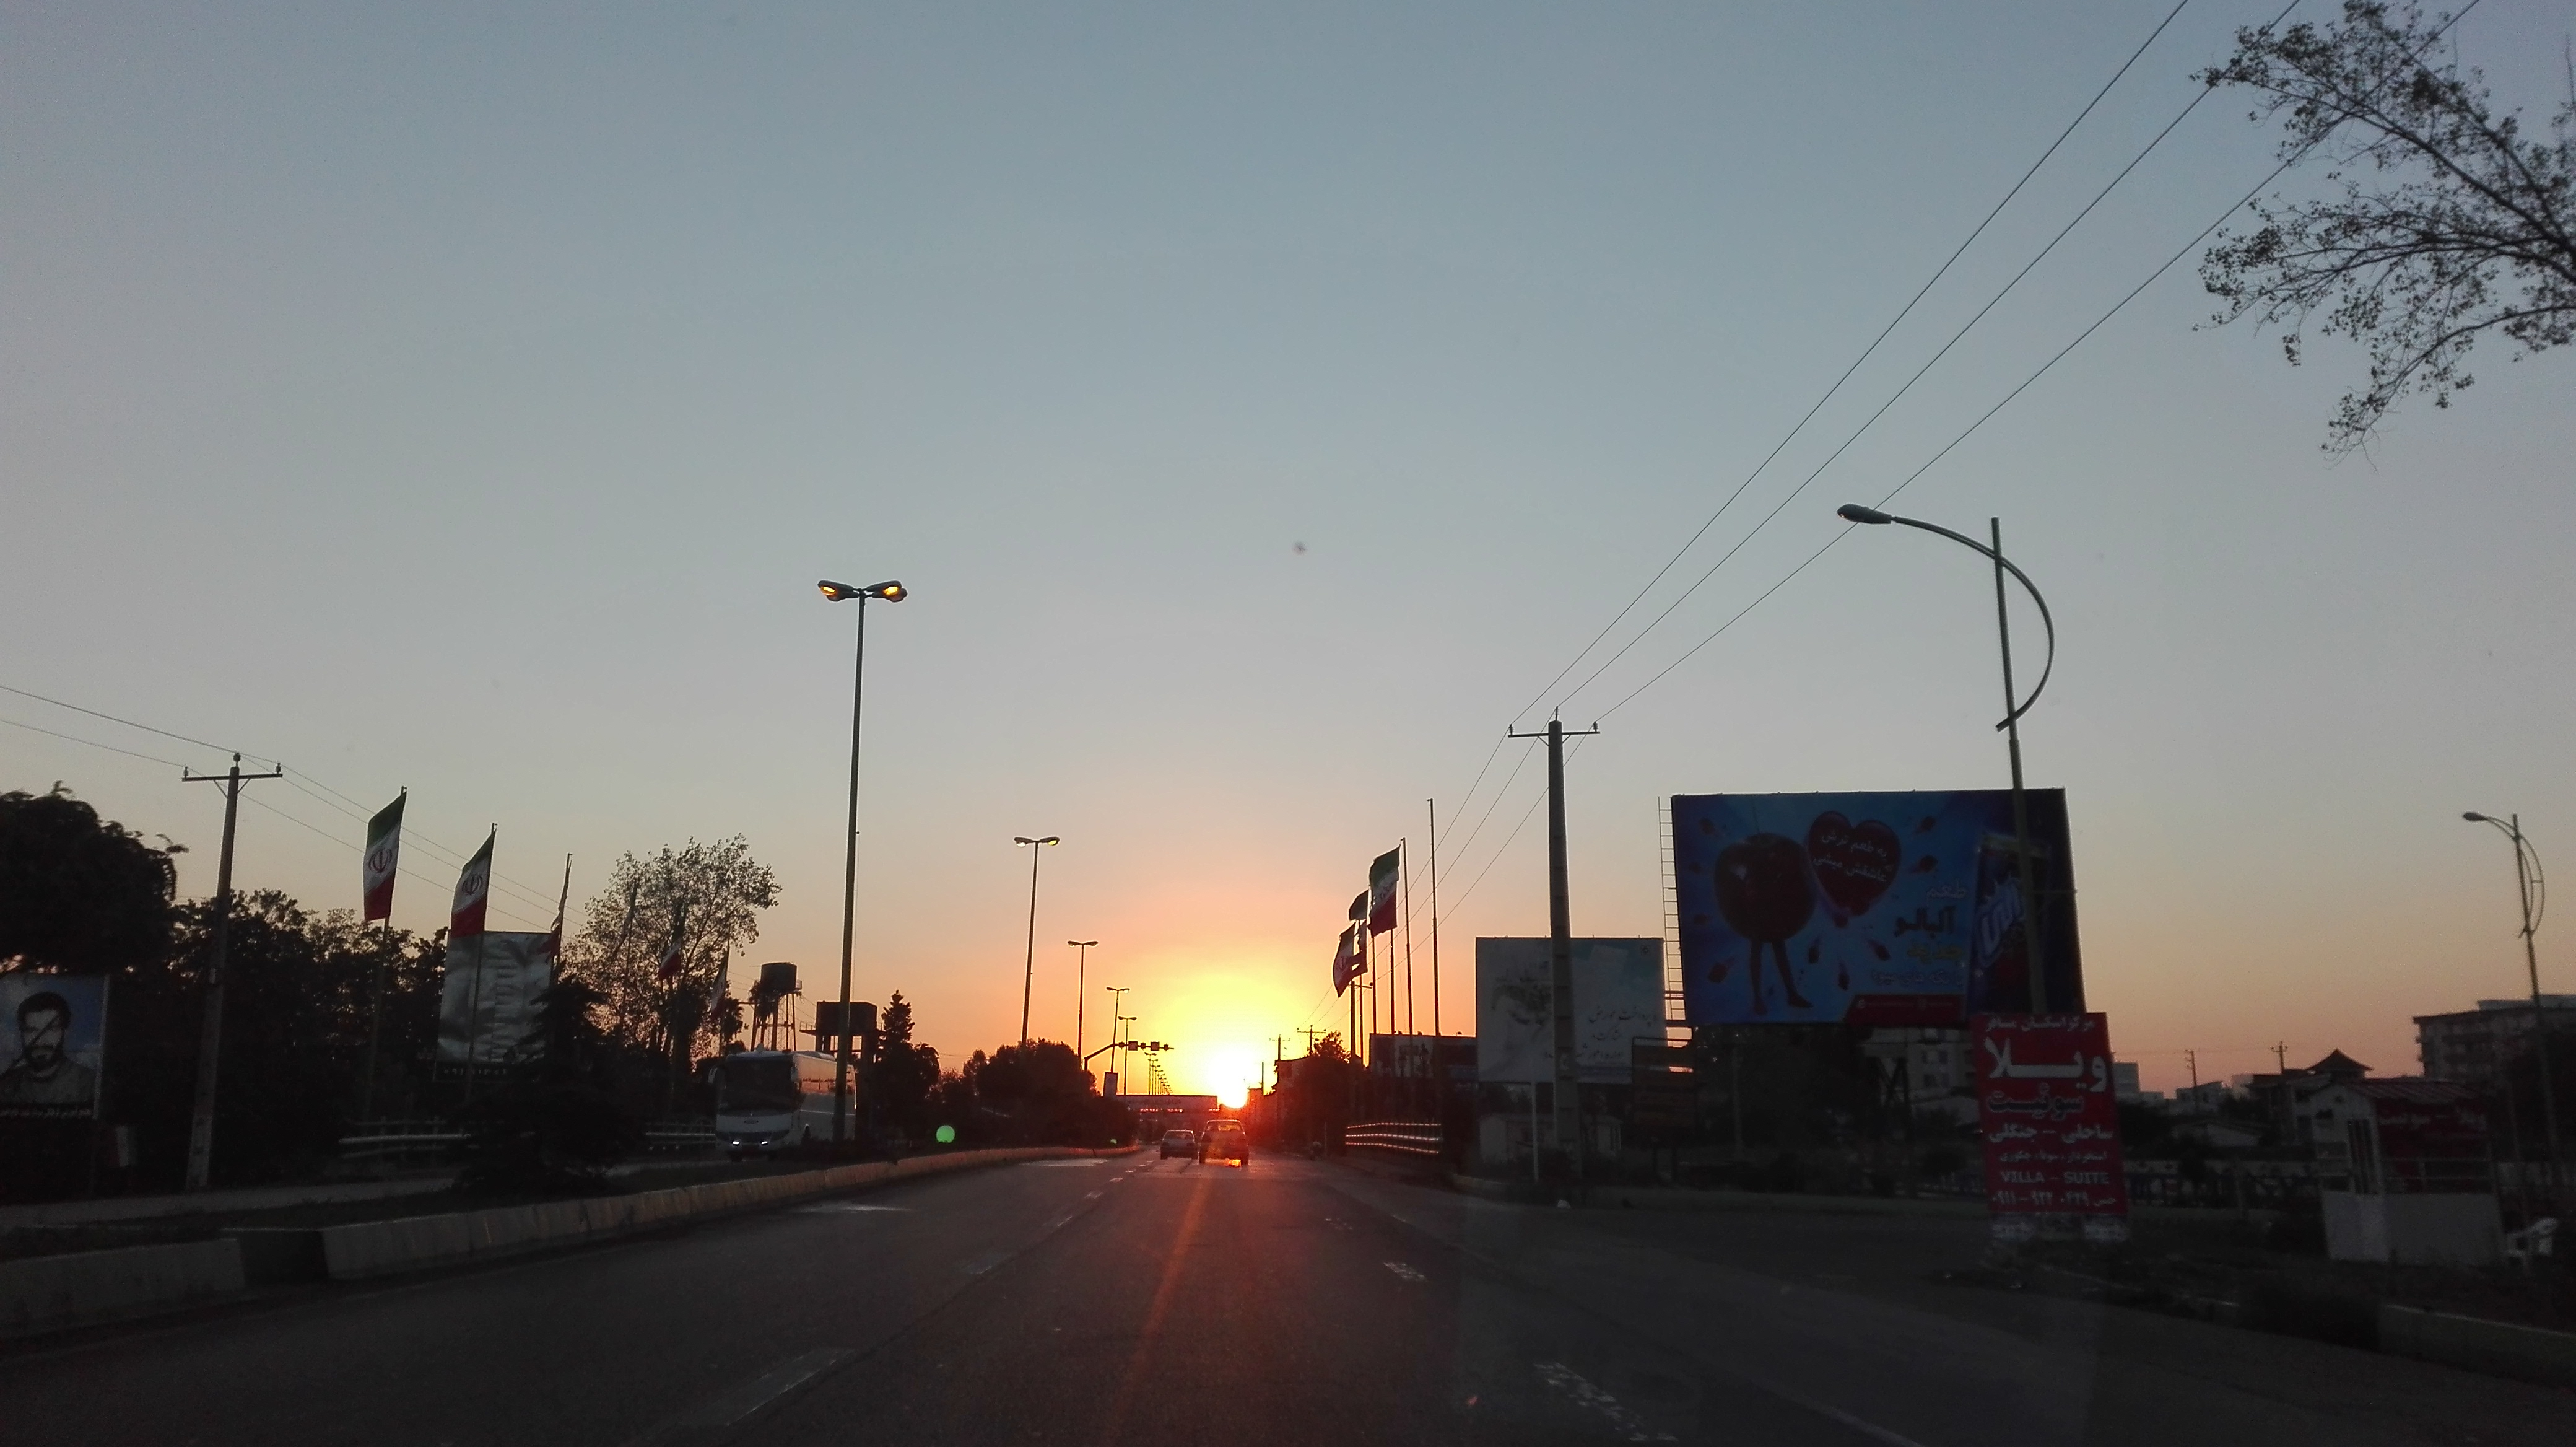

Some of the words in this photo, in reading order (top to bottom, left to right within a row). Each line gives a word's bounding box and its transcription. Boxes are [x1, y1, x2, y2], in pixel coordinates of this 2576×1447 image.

[1926, 880, 1967, 906] طعم
[1894, 905, 1957, 938] آلبالو
[1983, 1036, 2107, 1093] ویلا
[1988, 1122, 2037, 1143] جنگلی
[2061, 1123, 2113, 1144] ساحلی
[2000, 1171, 2045, 1183] VILLA
[2063, 1171, 2110, 1184] SUITE
